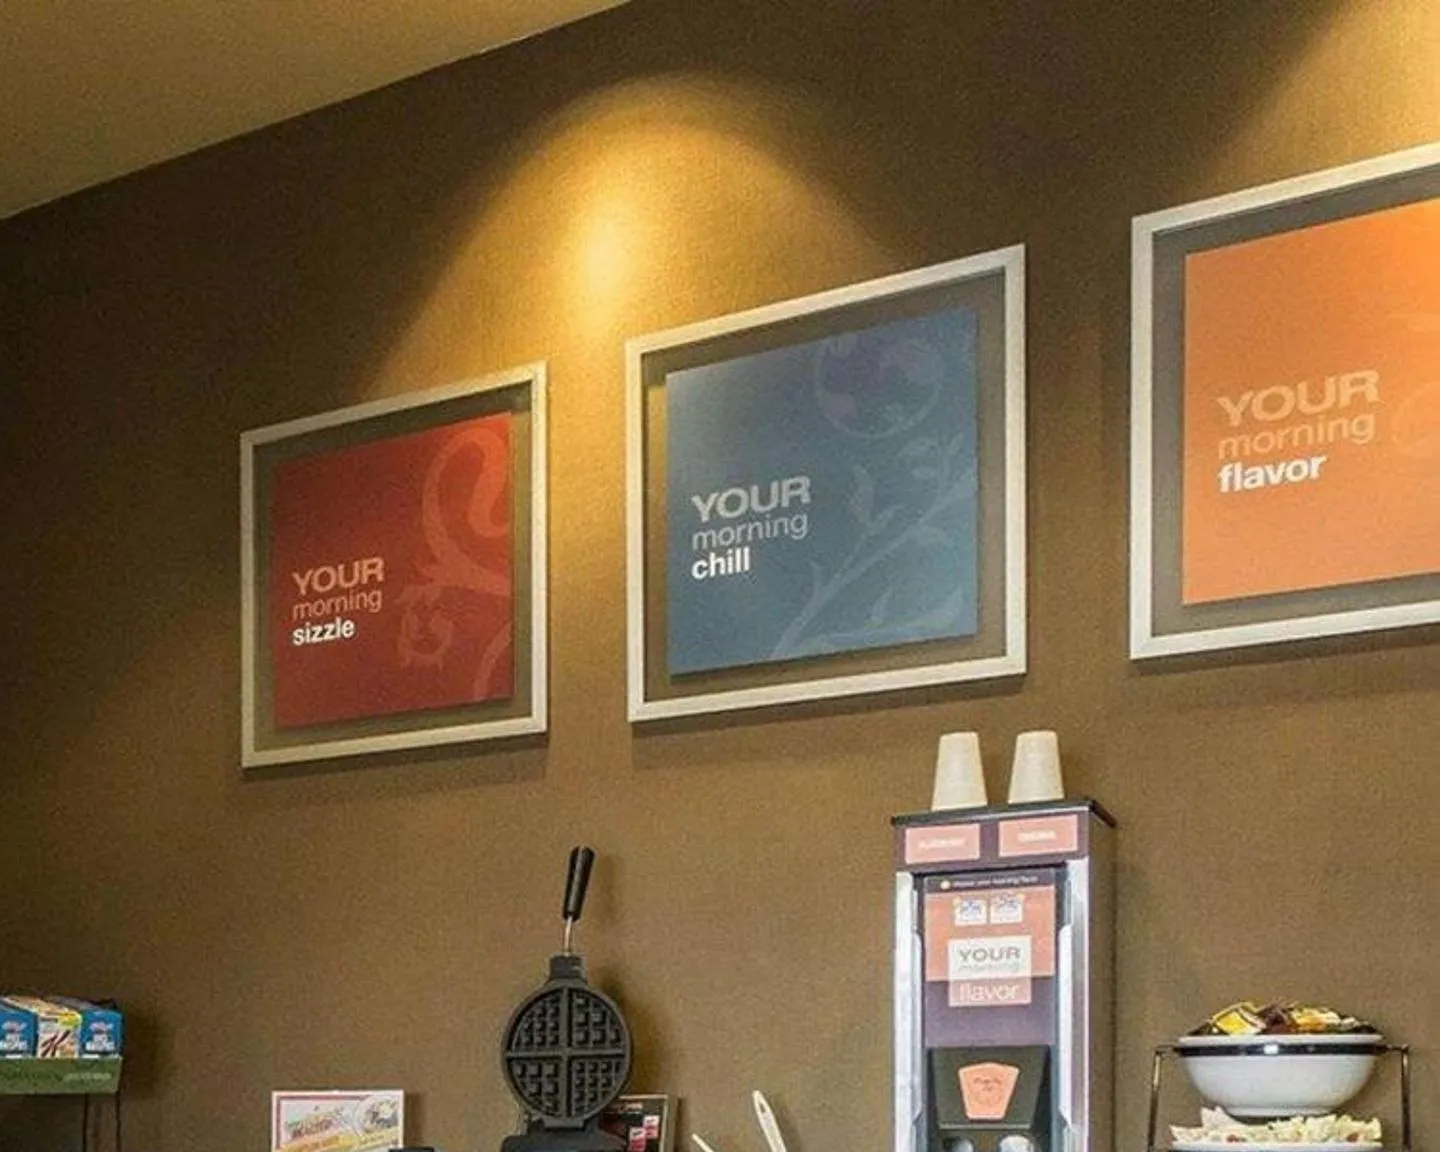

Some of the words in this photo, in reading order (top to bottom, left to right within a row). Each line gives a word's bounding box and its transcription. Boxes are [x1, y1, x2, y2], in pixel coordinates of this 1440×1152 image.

[1217, 369, 1380, 427] YOUR
[1218, 413, 1376, 460] morning
[1217, 454, 1328, 493] flavor
[691, 475, 811, 523] YOUR
[692, 513, 808, 550] morning
[291, 557, 385, 596] YOUR
[691, 546, 750, 580] chill
[292, 589, 382, 621] morning
[292, 616, 356, 646] sizzle
[959, 945, 1022, 963] YOUR
